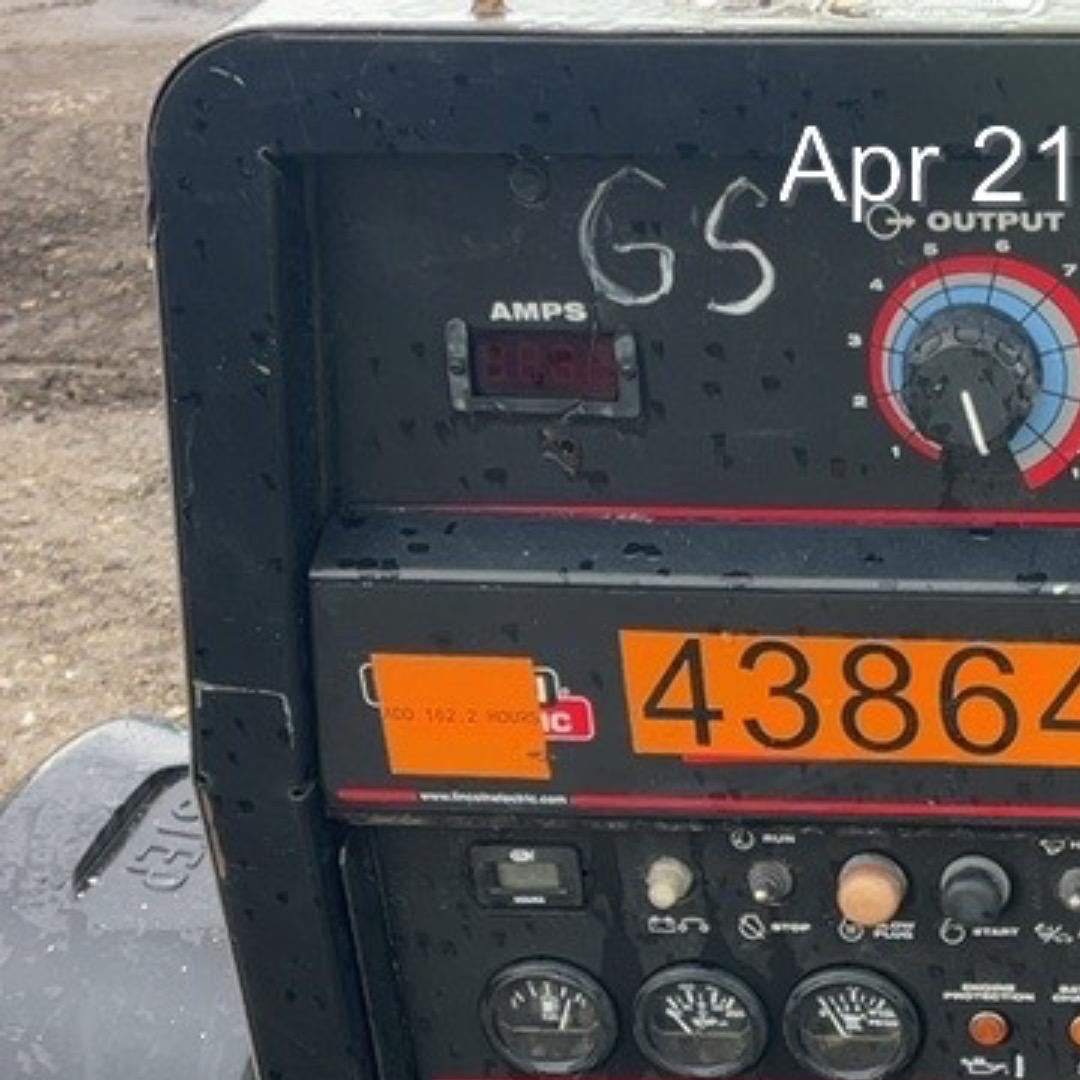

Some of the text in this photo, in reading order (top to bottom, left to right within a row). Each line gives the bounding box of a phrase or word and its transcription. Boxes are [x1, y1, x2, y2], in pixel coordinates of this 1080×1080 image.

[926, 211, 1065, 232] OUTPUT
[923, 243, 939, 256] 5
[995, 239, 1011, 252] 6
[1062, 263, 1078, 277] 7
[869, 278, 884, 291] 4
[490, 301, 588, 323] AMPS
[848, 334, 862, 347] 3
[851, 395, 868, 408] 2
[891, 445, 901, 459] 1
[770, 921, 812, 932] STOP
[973, 926, 1020, 937] START
